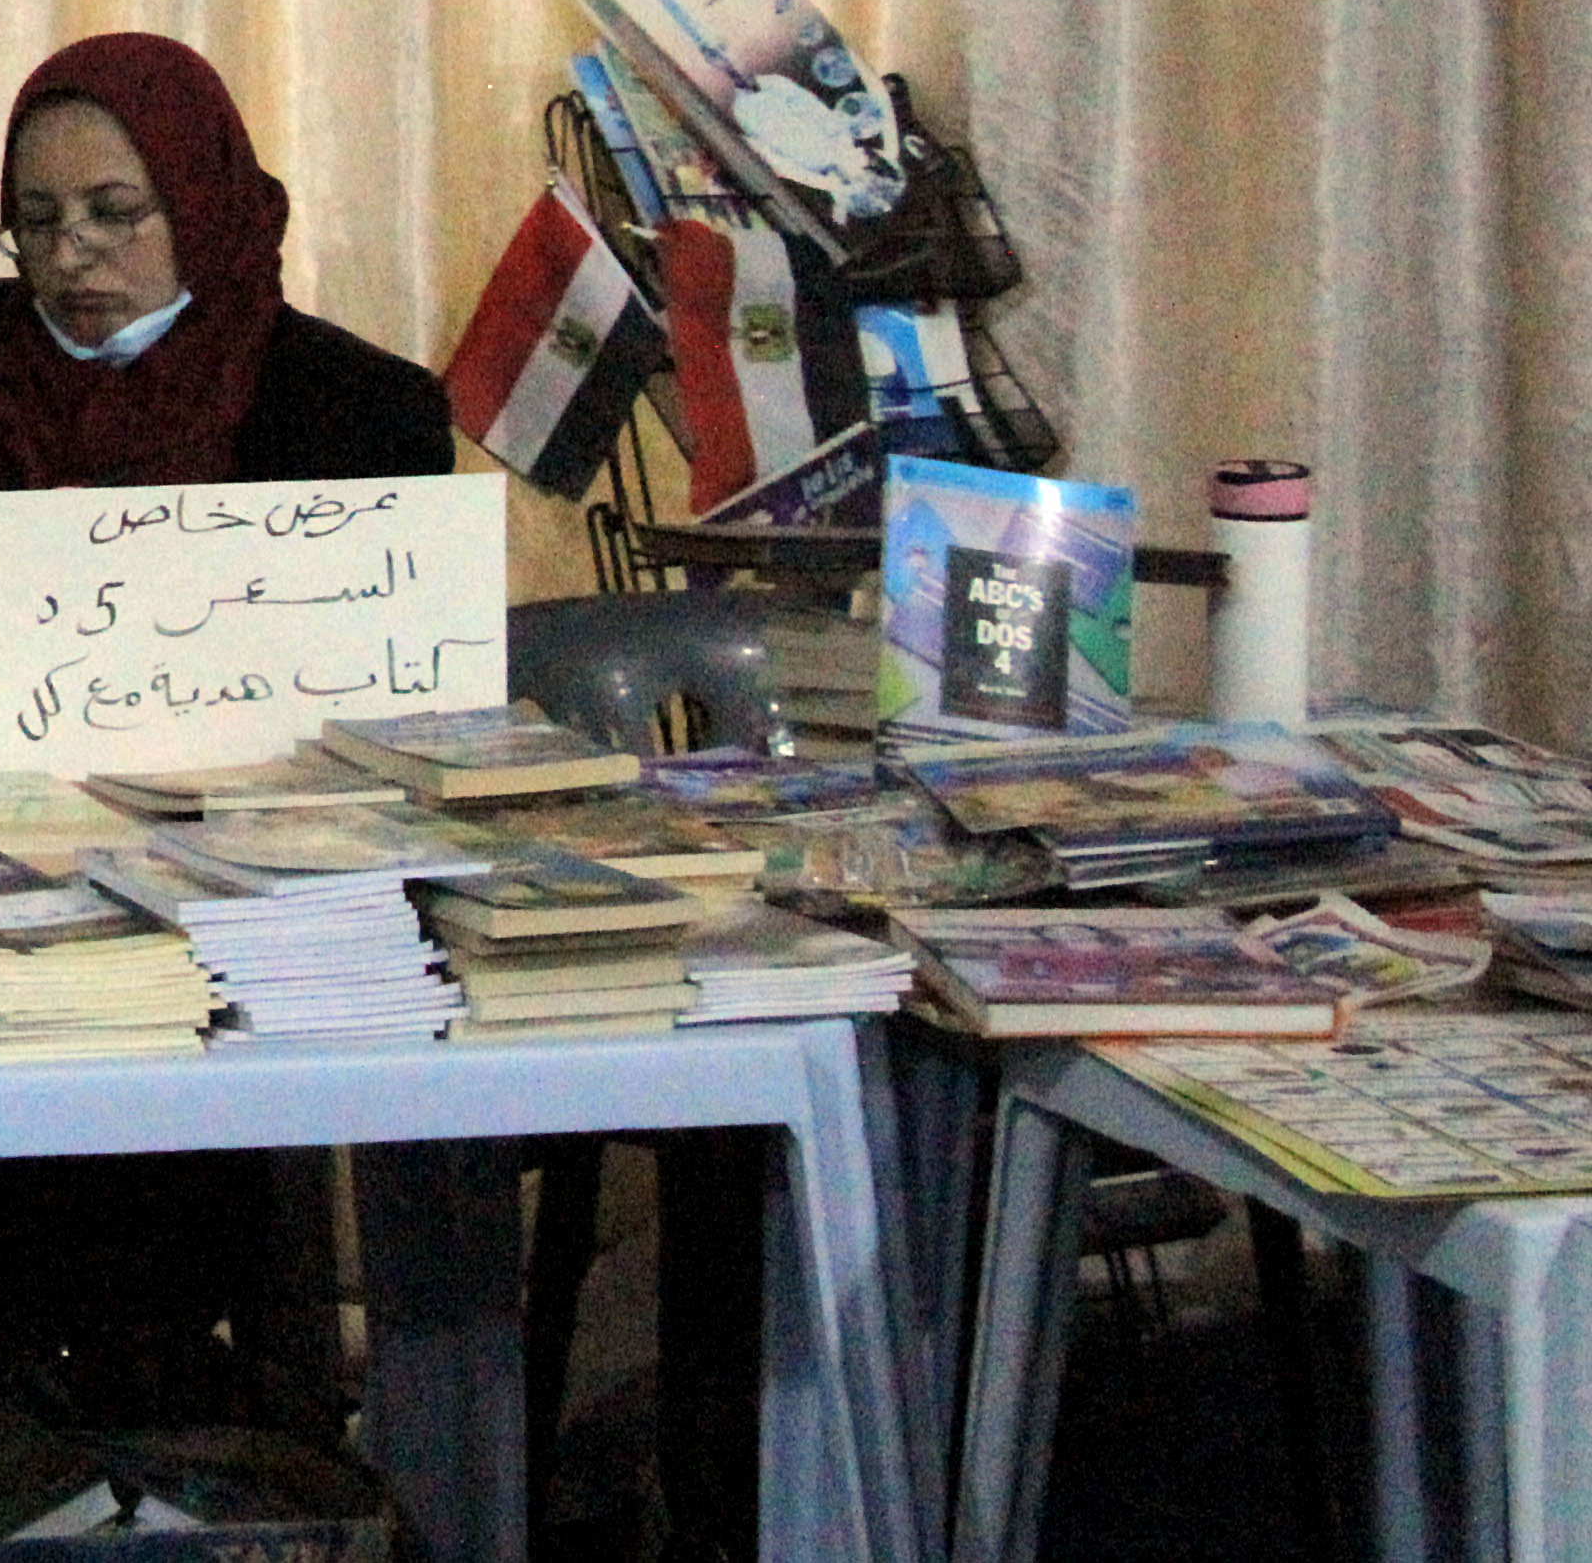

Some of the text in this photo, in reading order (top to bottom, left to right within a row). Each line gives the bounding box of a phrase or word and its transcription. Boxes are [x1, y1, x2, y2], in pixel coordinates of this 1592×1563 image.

[88, 489, 400, 545] عرض خاص
[76, 580, 126, 636] 5
[976, 618, 1035, 652] DOS
[16, 637, 497, 742] كتاب هدية مع كل
[993, 650, 1012, 676] 4
